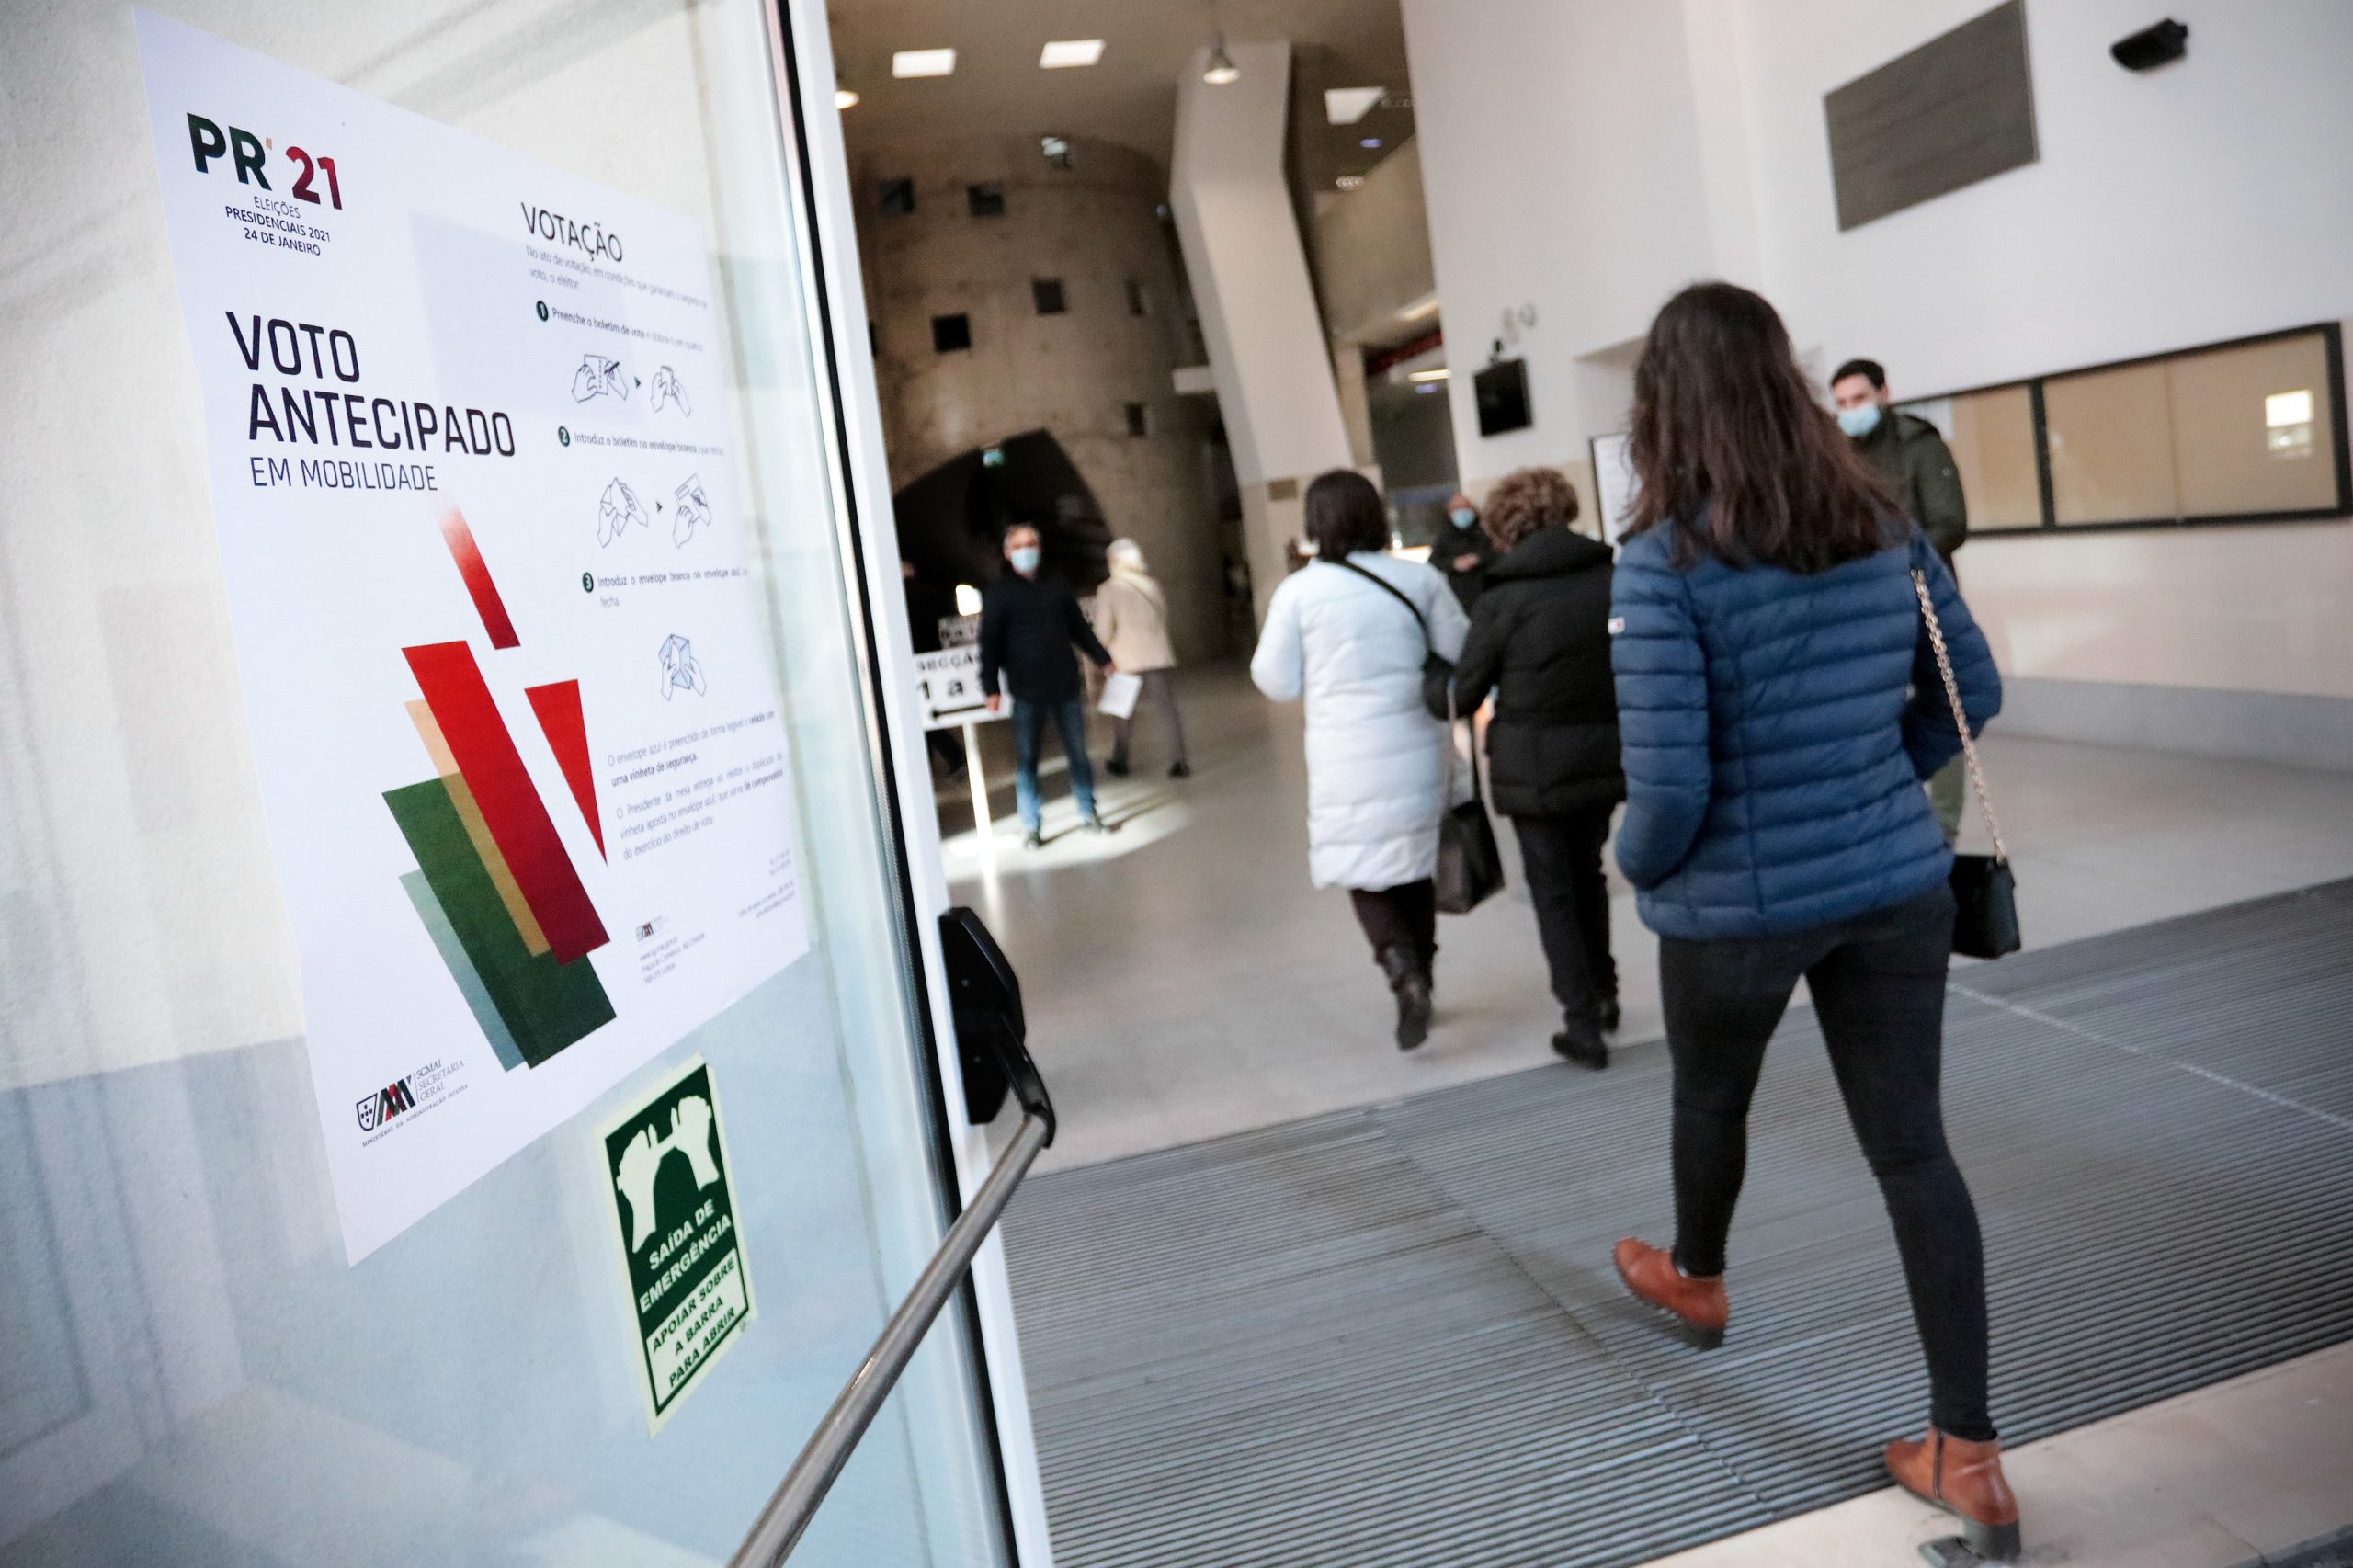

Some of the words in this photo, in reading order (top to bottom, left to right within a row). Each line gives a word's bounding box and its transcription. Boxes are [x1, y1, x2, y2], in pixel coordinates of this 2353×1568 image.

[225, 206, 307, 236] PRESIDENCIAIS
[308, 227, 331, 243] 2021
[254, 196, 301, 219] ELEIÇÕES
[244, 227, 258, 241] 24
[261, 232, 277, 245] DE
[278, 237, 322, 256] JANEIRO
[520, 201, 623, 262] VOTAÇÃO
[551, 307, 585, 325] Preenche
[593, 317, 620, 334] boletim
[621, 324, 630, 335] de
[224, 311, 360, 383] VOTO
[248, 383, 516, 458] ANTECIPADO
[574, 432, 604, 447] Introduz
[612, 436, 638, 449] boletim
[649, 439, 676, 453] envelope
[250, 457, 293, 487] EM
[300, 459, 438, 492] MOBILIDADE
[597, 574, 628, 588] Introduz
[638, 573, 667, 585] envelope
[670, 571, 690, 582] branco
[617, 747, 648, 765] envelope
[611, 775, 629, 788] uma
[630, 764, 655, 781] vinheta
[655, 761, 665, 773] de
[627, 795, 661, 815] Presidente
[620, 823, 645, 839] vinheta
[649, 1220, 694, 1271] SAÍDA
[694, 1199, 716, 1225] DE
[639, 1213, 733, 1314] EMERGÊNCIA
[652, 1298, 698, 1353] APOIAR
[699, 1257, 736, 1303] SOBRE
[675, 1339, 684, 1357] A
[685, 1297, 724, 1342] BARRA
[668, 1346, 700, 1388] PARA
[701, 1306, 735, 1350] ABRIR
